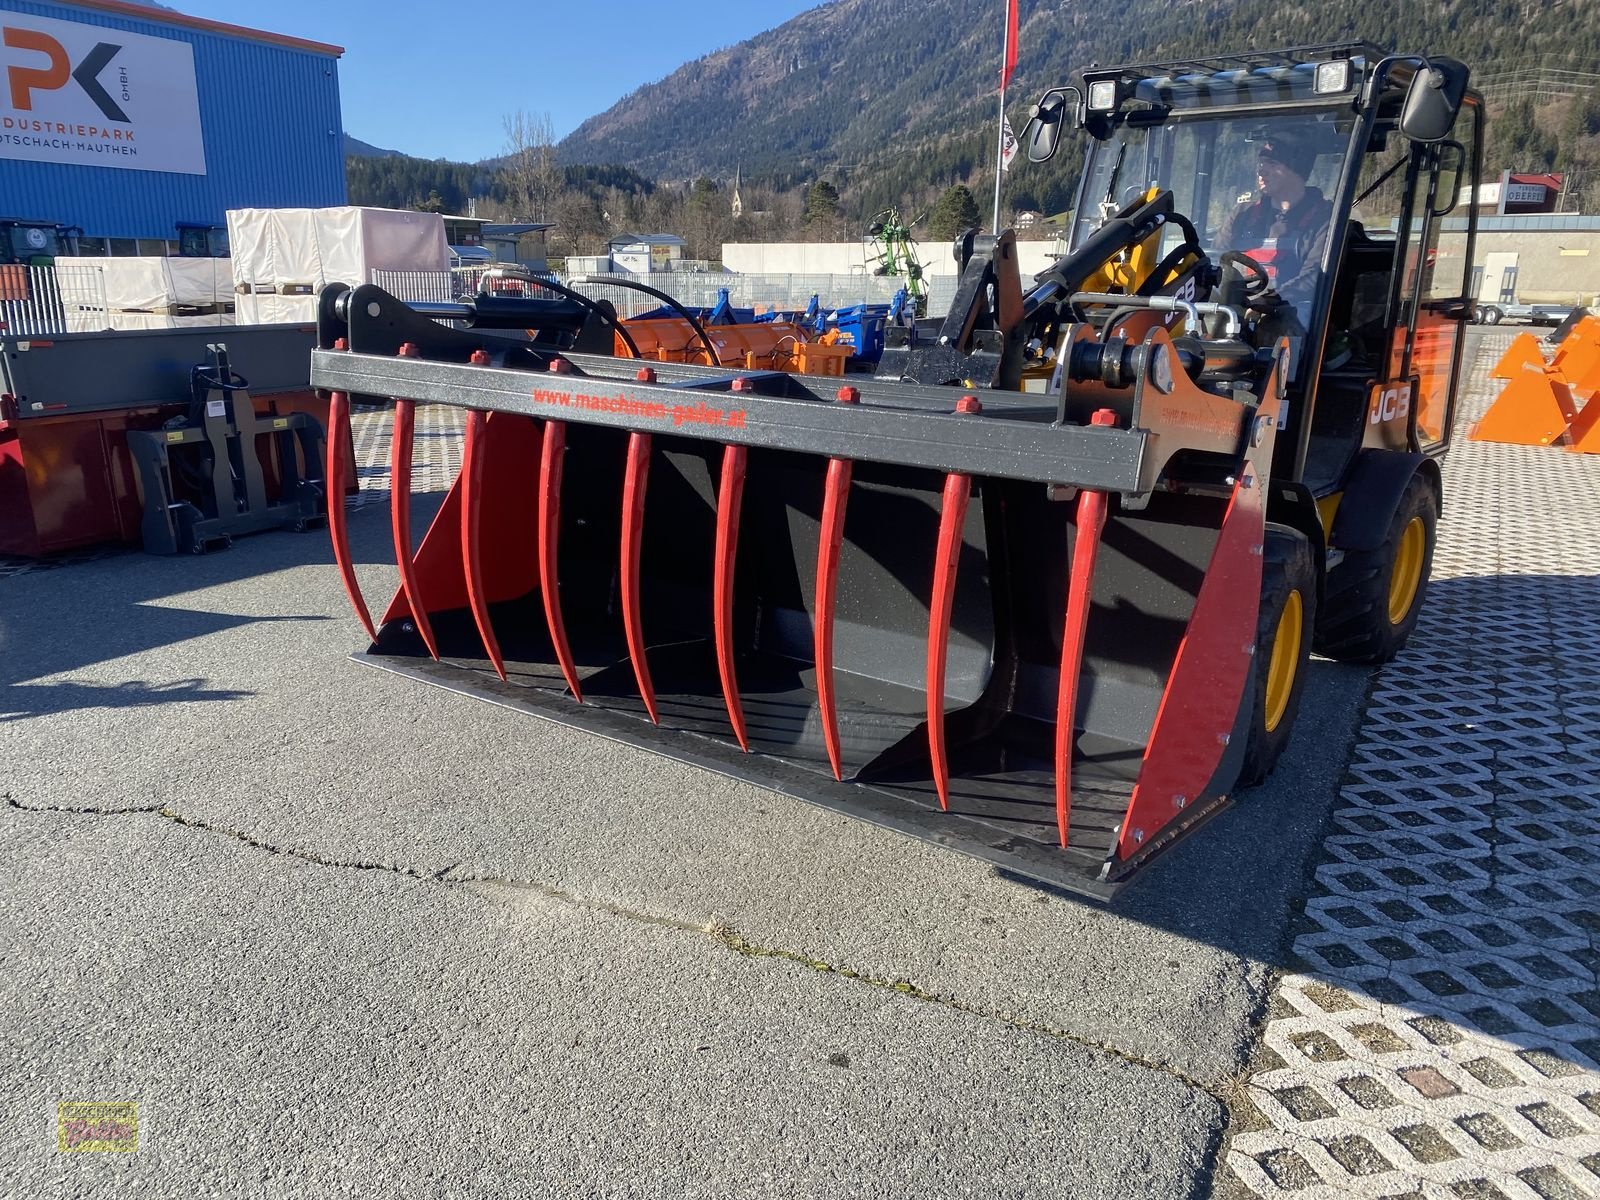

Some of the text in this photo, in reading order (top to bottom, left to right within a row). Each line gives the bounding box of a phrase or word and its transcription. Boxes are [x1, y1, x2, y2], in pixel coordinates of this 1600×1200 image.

[118, 66, 130, 102] GMBH
[3, 117, 135, 141] DUSTRIEPARK
[533, 388, 747, 430] www.maschinen-gailer.at
[1371, 386, 1411, 425] JCB
